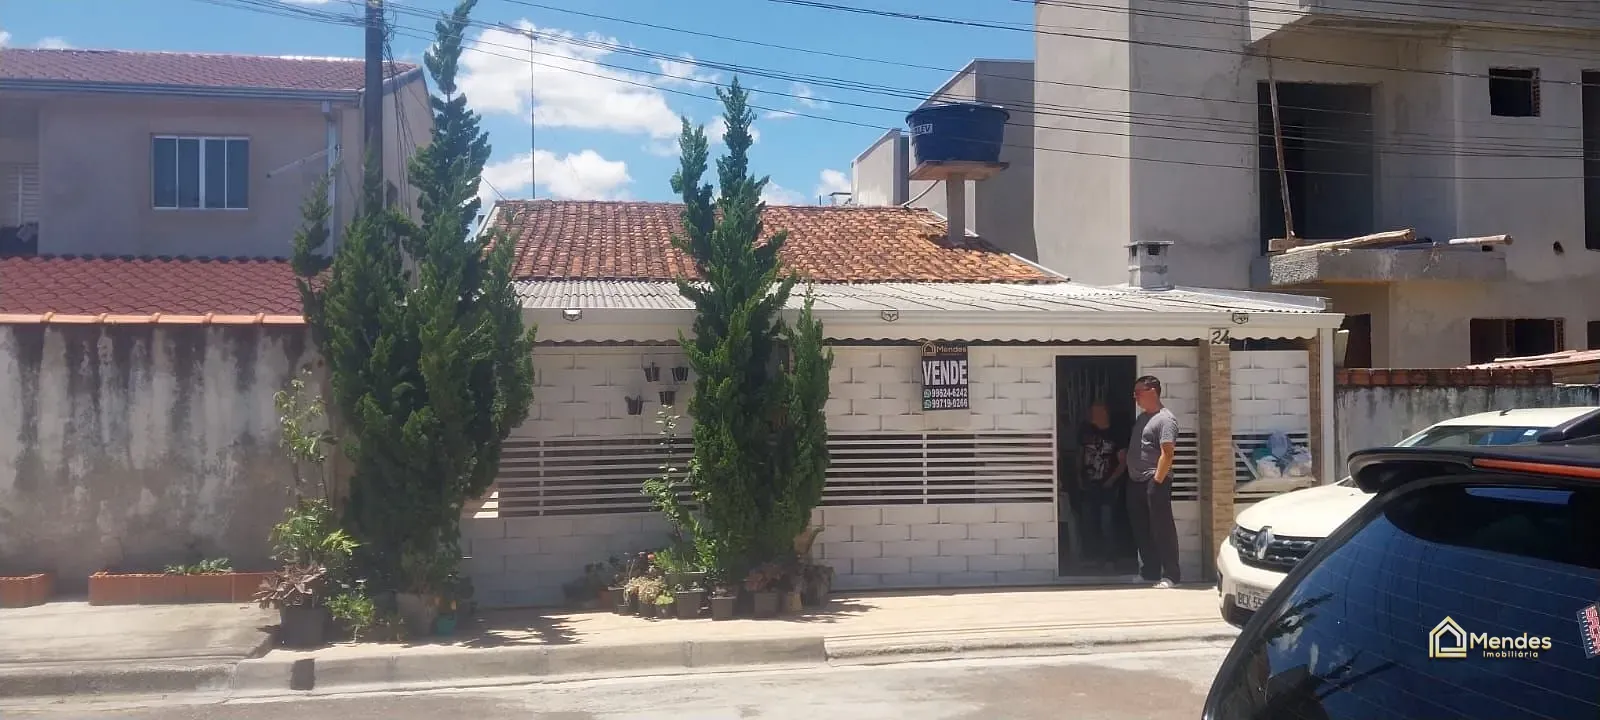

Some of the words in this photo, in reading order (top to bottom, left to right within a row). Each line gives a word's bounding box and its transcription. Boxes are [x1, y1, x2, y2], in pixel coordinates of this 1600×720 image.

[1211, 330, 1230, 345] 24
[936, 344, 967, 353] Mendes
[923, 360, 968, 386] VENDE
